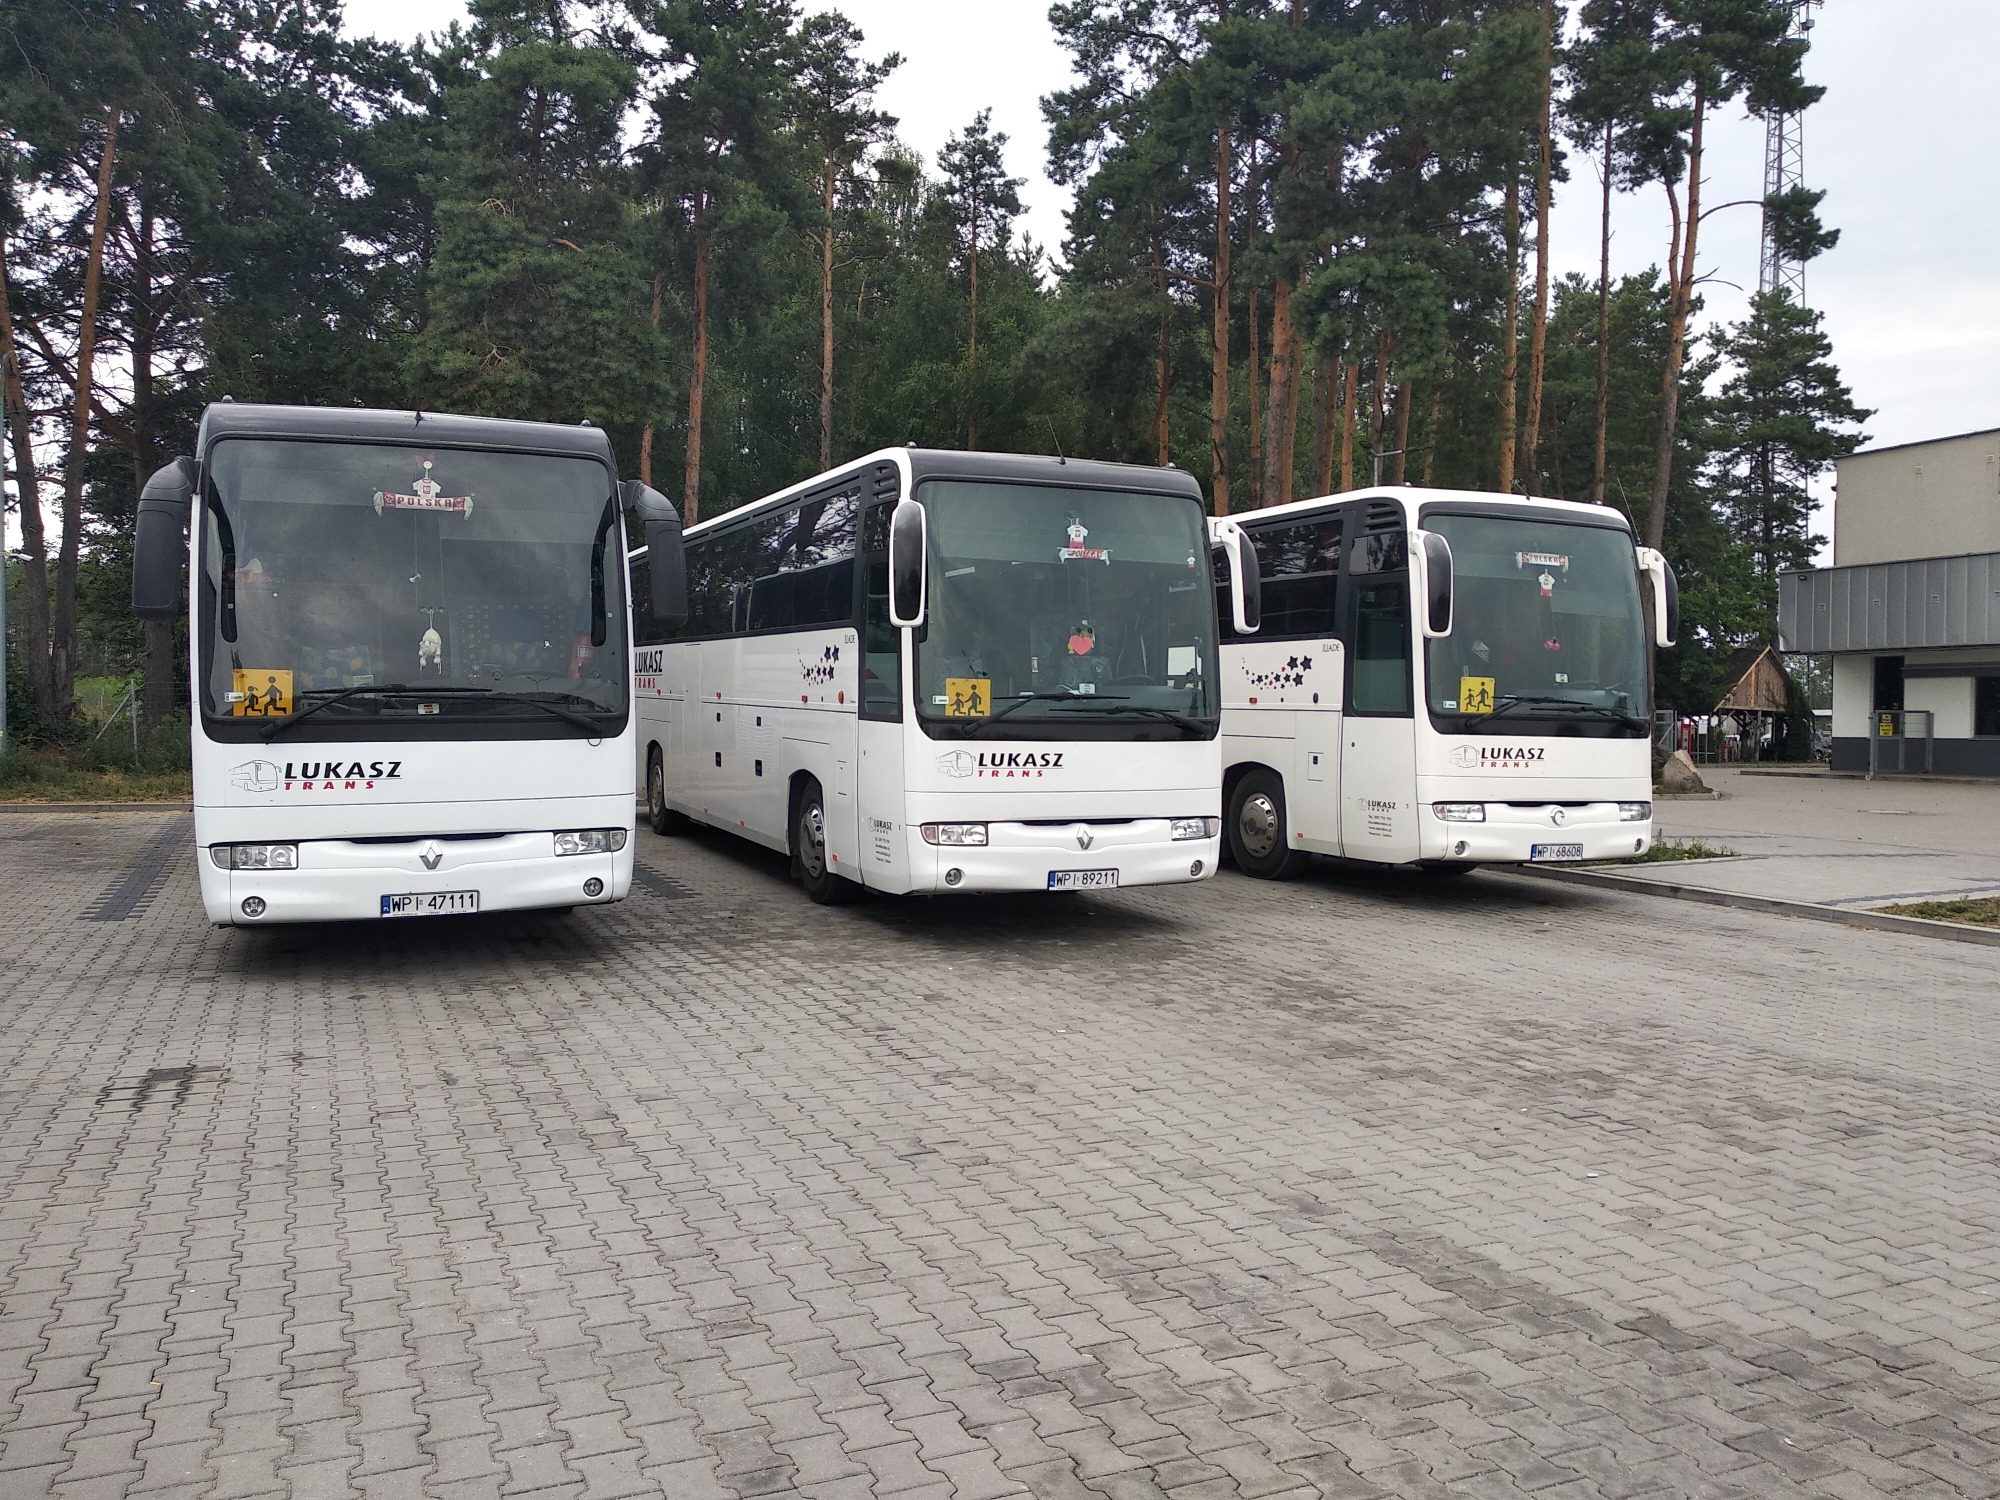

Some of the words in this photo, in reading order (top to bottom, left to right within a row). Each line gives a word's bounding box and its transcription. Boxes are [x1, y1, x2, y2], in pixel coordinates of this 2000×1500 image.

[397, 496, 452, 507] POLSKA
[1529, 555, 1559, 563] POLSKA
[635, 650, 663, 674] LUKASZ
[1481, 747, 1545, 760] LUKASZ
[978, 753, 1064, 767] LUKASZ
[284, 761, 402, 779] LUKASZ
[978, 770, 1043, 778] TRANS
[284, 781, 375, 791] TRANS
[1367, 800, 1396, 809] LUKASZ
[1537, 846, 1553, 858] WPI
[1555, 846, 1582, 858] 68608
[1056, 873, 1077, 886] WPI
[1081, 872, 1115, 886] 89211
[391, 896, 419, 912] WPI
[427, 893, 474, 910] 47111
